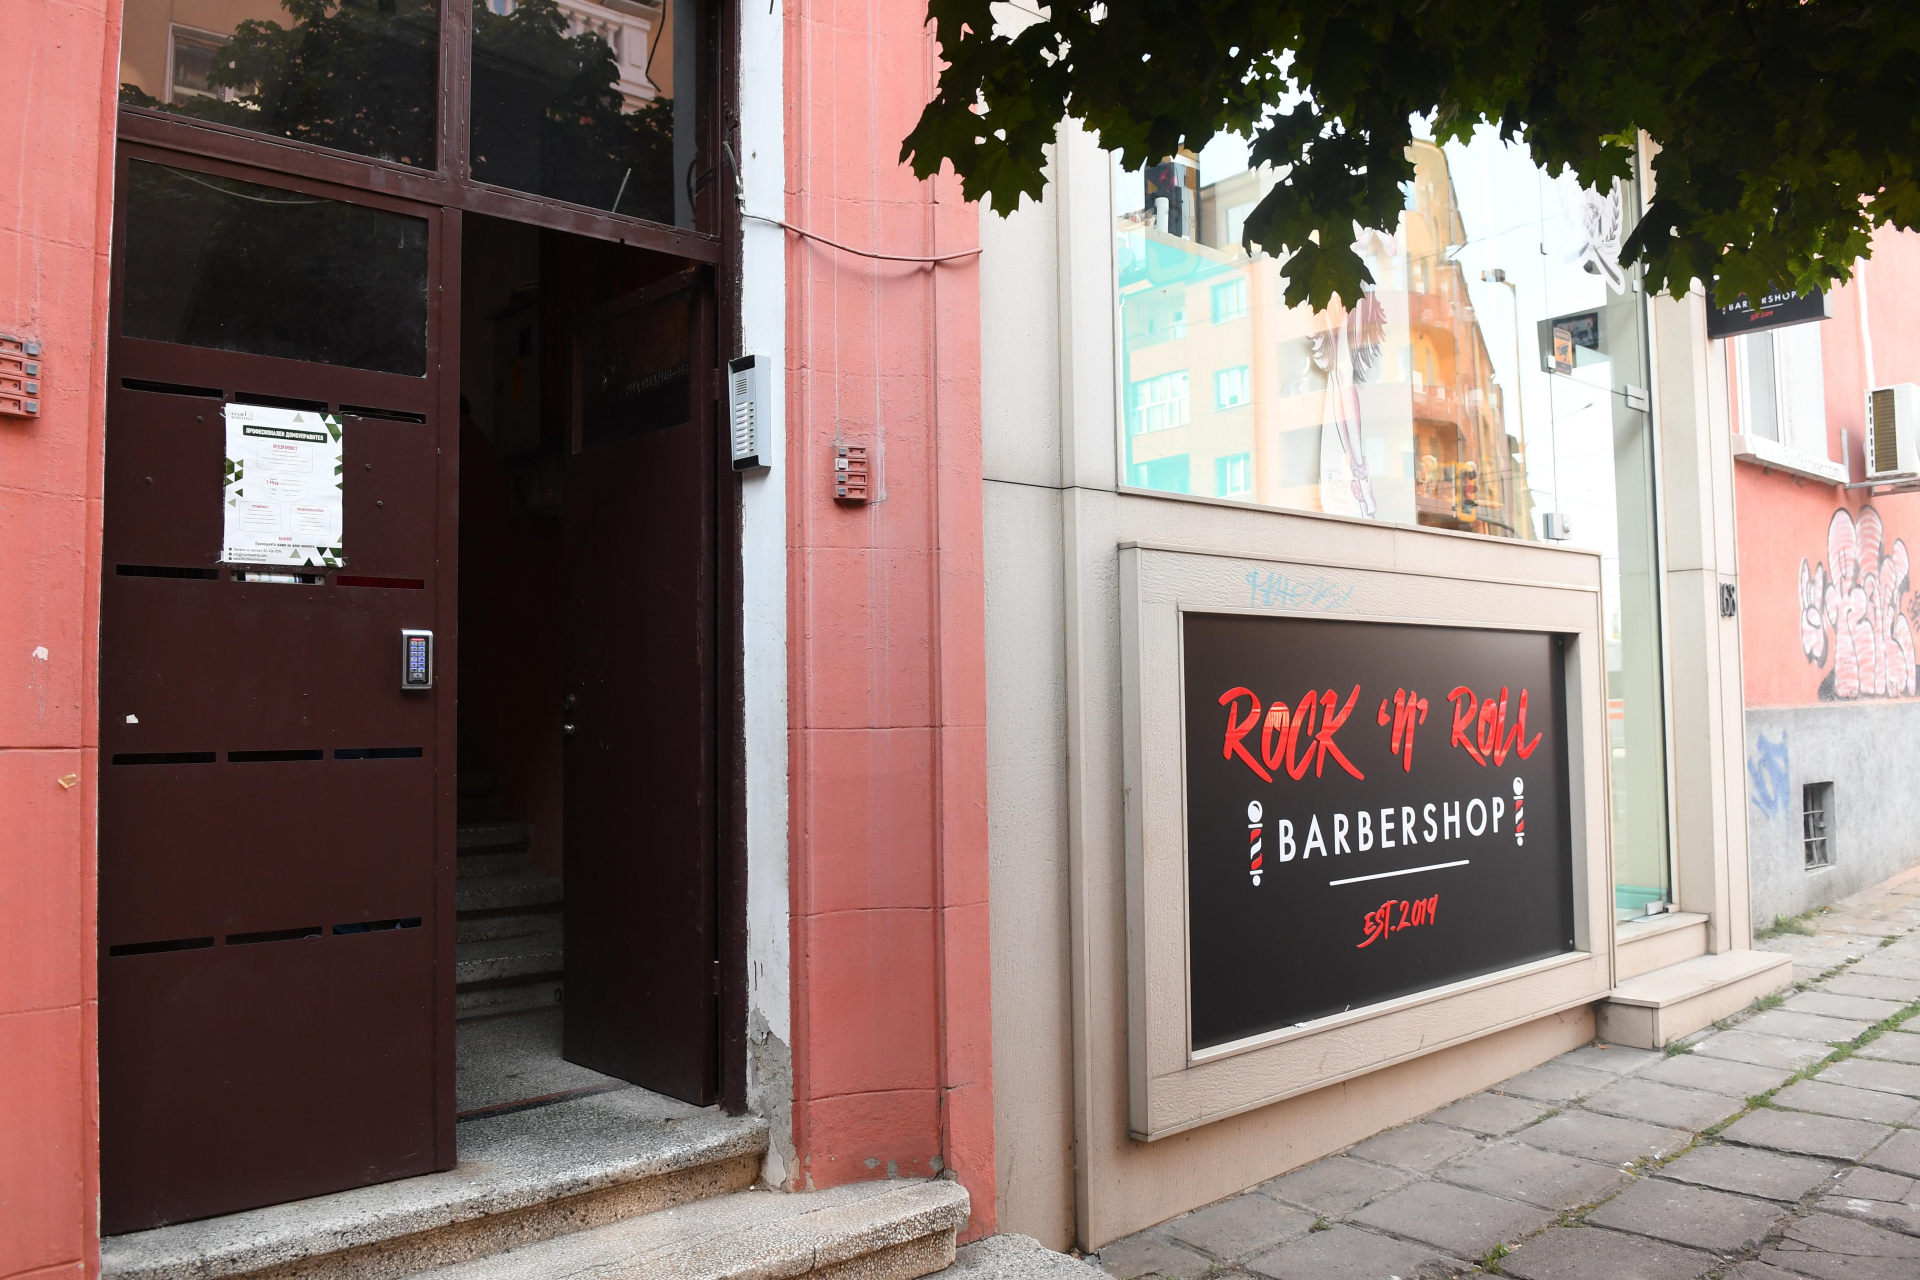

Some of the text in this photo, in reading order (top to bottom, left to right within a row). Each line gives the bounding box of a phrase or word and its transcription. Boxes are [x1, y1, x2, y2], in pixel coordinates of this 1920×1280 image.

[1728, 290, 1797, 311] BARRSHOP
[1218, 684, 1365, 783] ROCK
[1446, 686, 1543, 767] ROLL
[1278, 796, 1506, 863] BARBERSHOP
